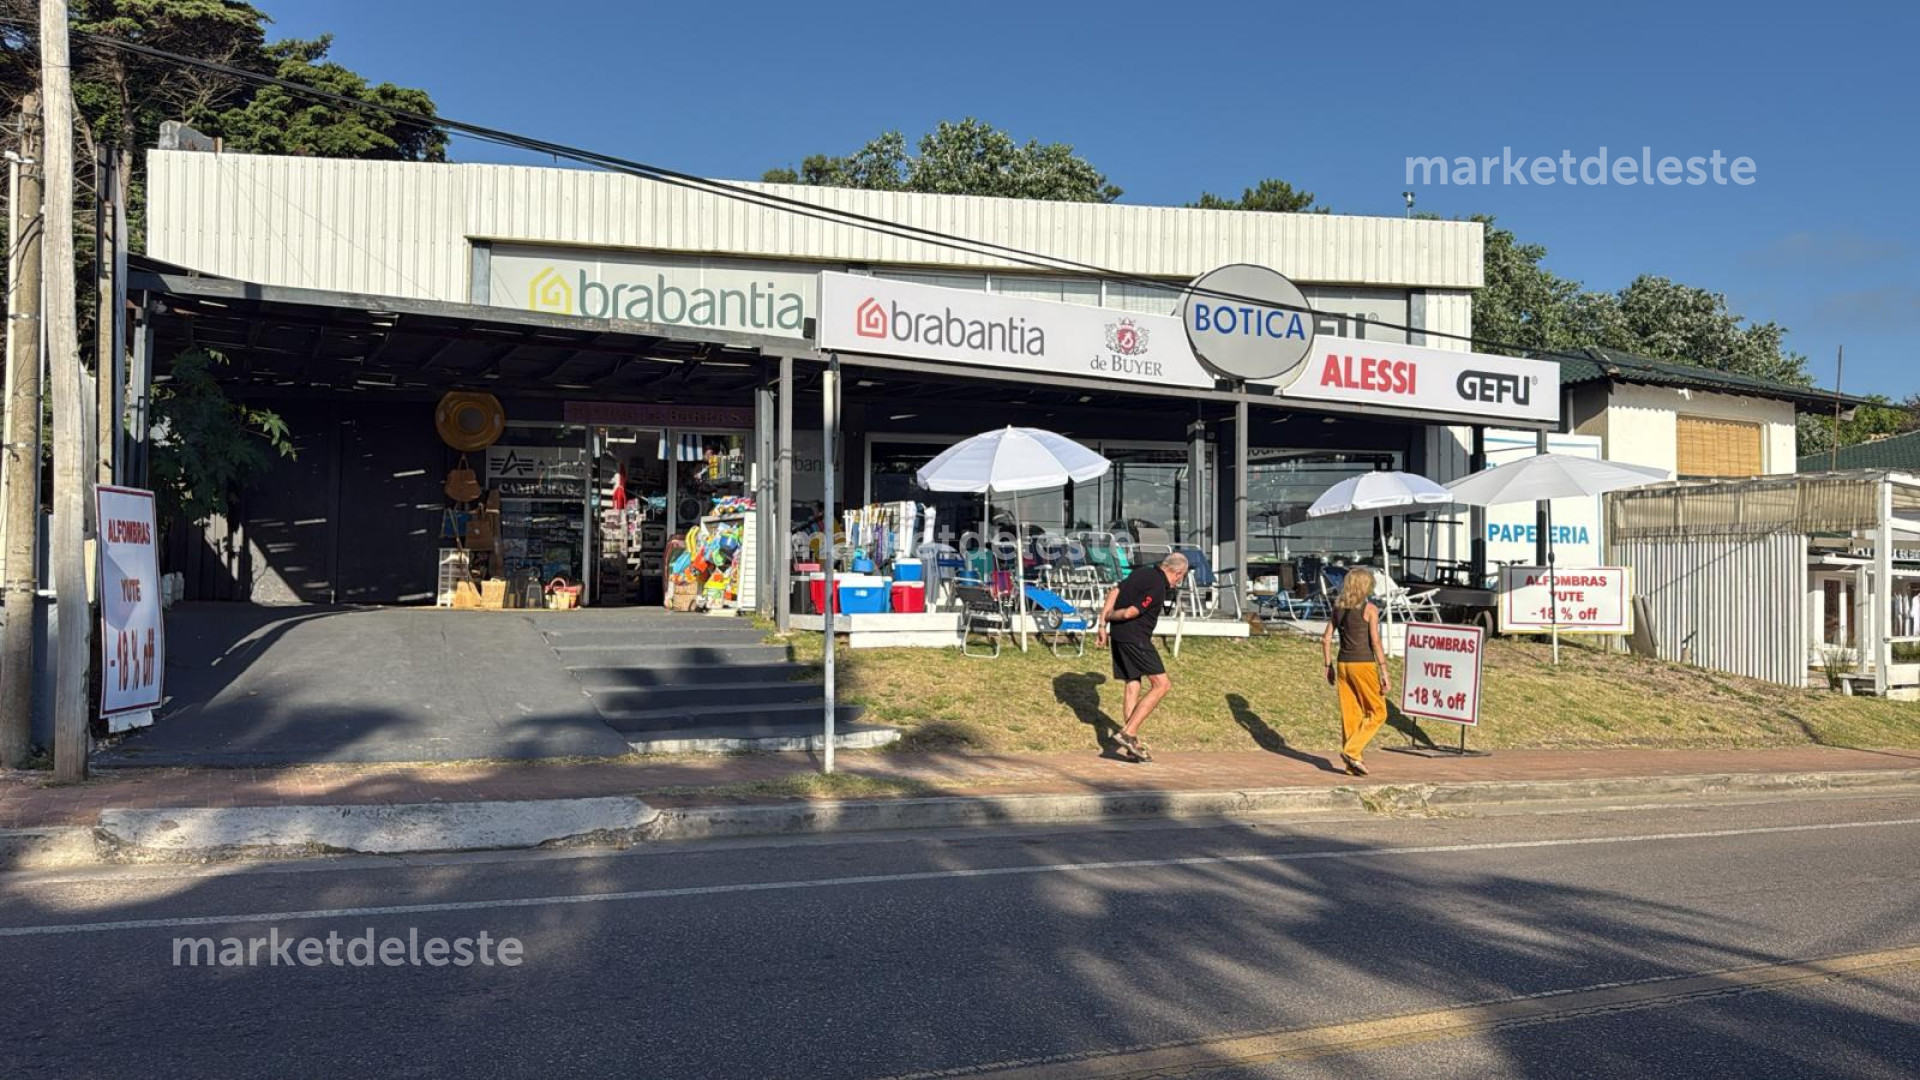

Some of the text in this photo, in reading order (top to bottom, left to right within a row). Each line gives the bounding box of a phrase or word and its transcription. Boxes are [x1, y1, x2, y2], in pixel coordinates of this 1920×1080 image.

[579, 269, 804, 330] brabantia
[891, 300, 1045, 357] brabantia
[1194, 303, 1305, 340] BOTICA
[1090, 355, 1162, 377] de BUYER
[1320, 354, 1417, 395] ALESSI
[108, 519, 151, 545] ALFOMBRAS
[1488, 523, 1589, 544] PAPEERIA
[120, 578, 142, 603] YUTE
[1578, 608, 1598, 620] off
[1408, 633, 1475, 654] ALFOMBRAS
[143, 626, 155, 687] off
[1423, 661, 1452, 679] YUTE
[1447, 691, 1466, 711] off
